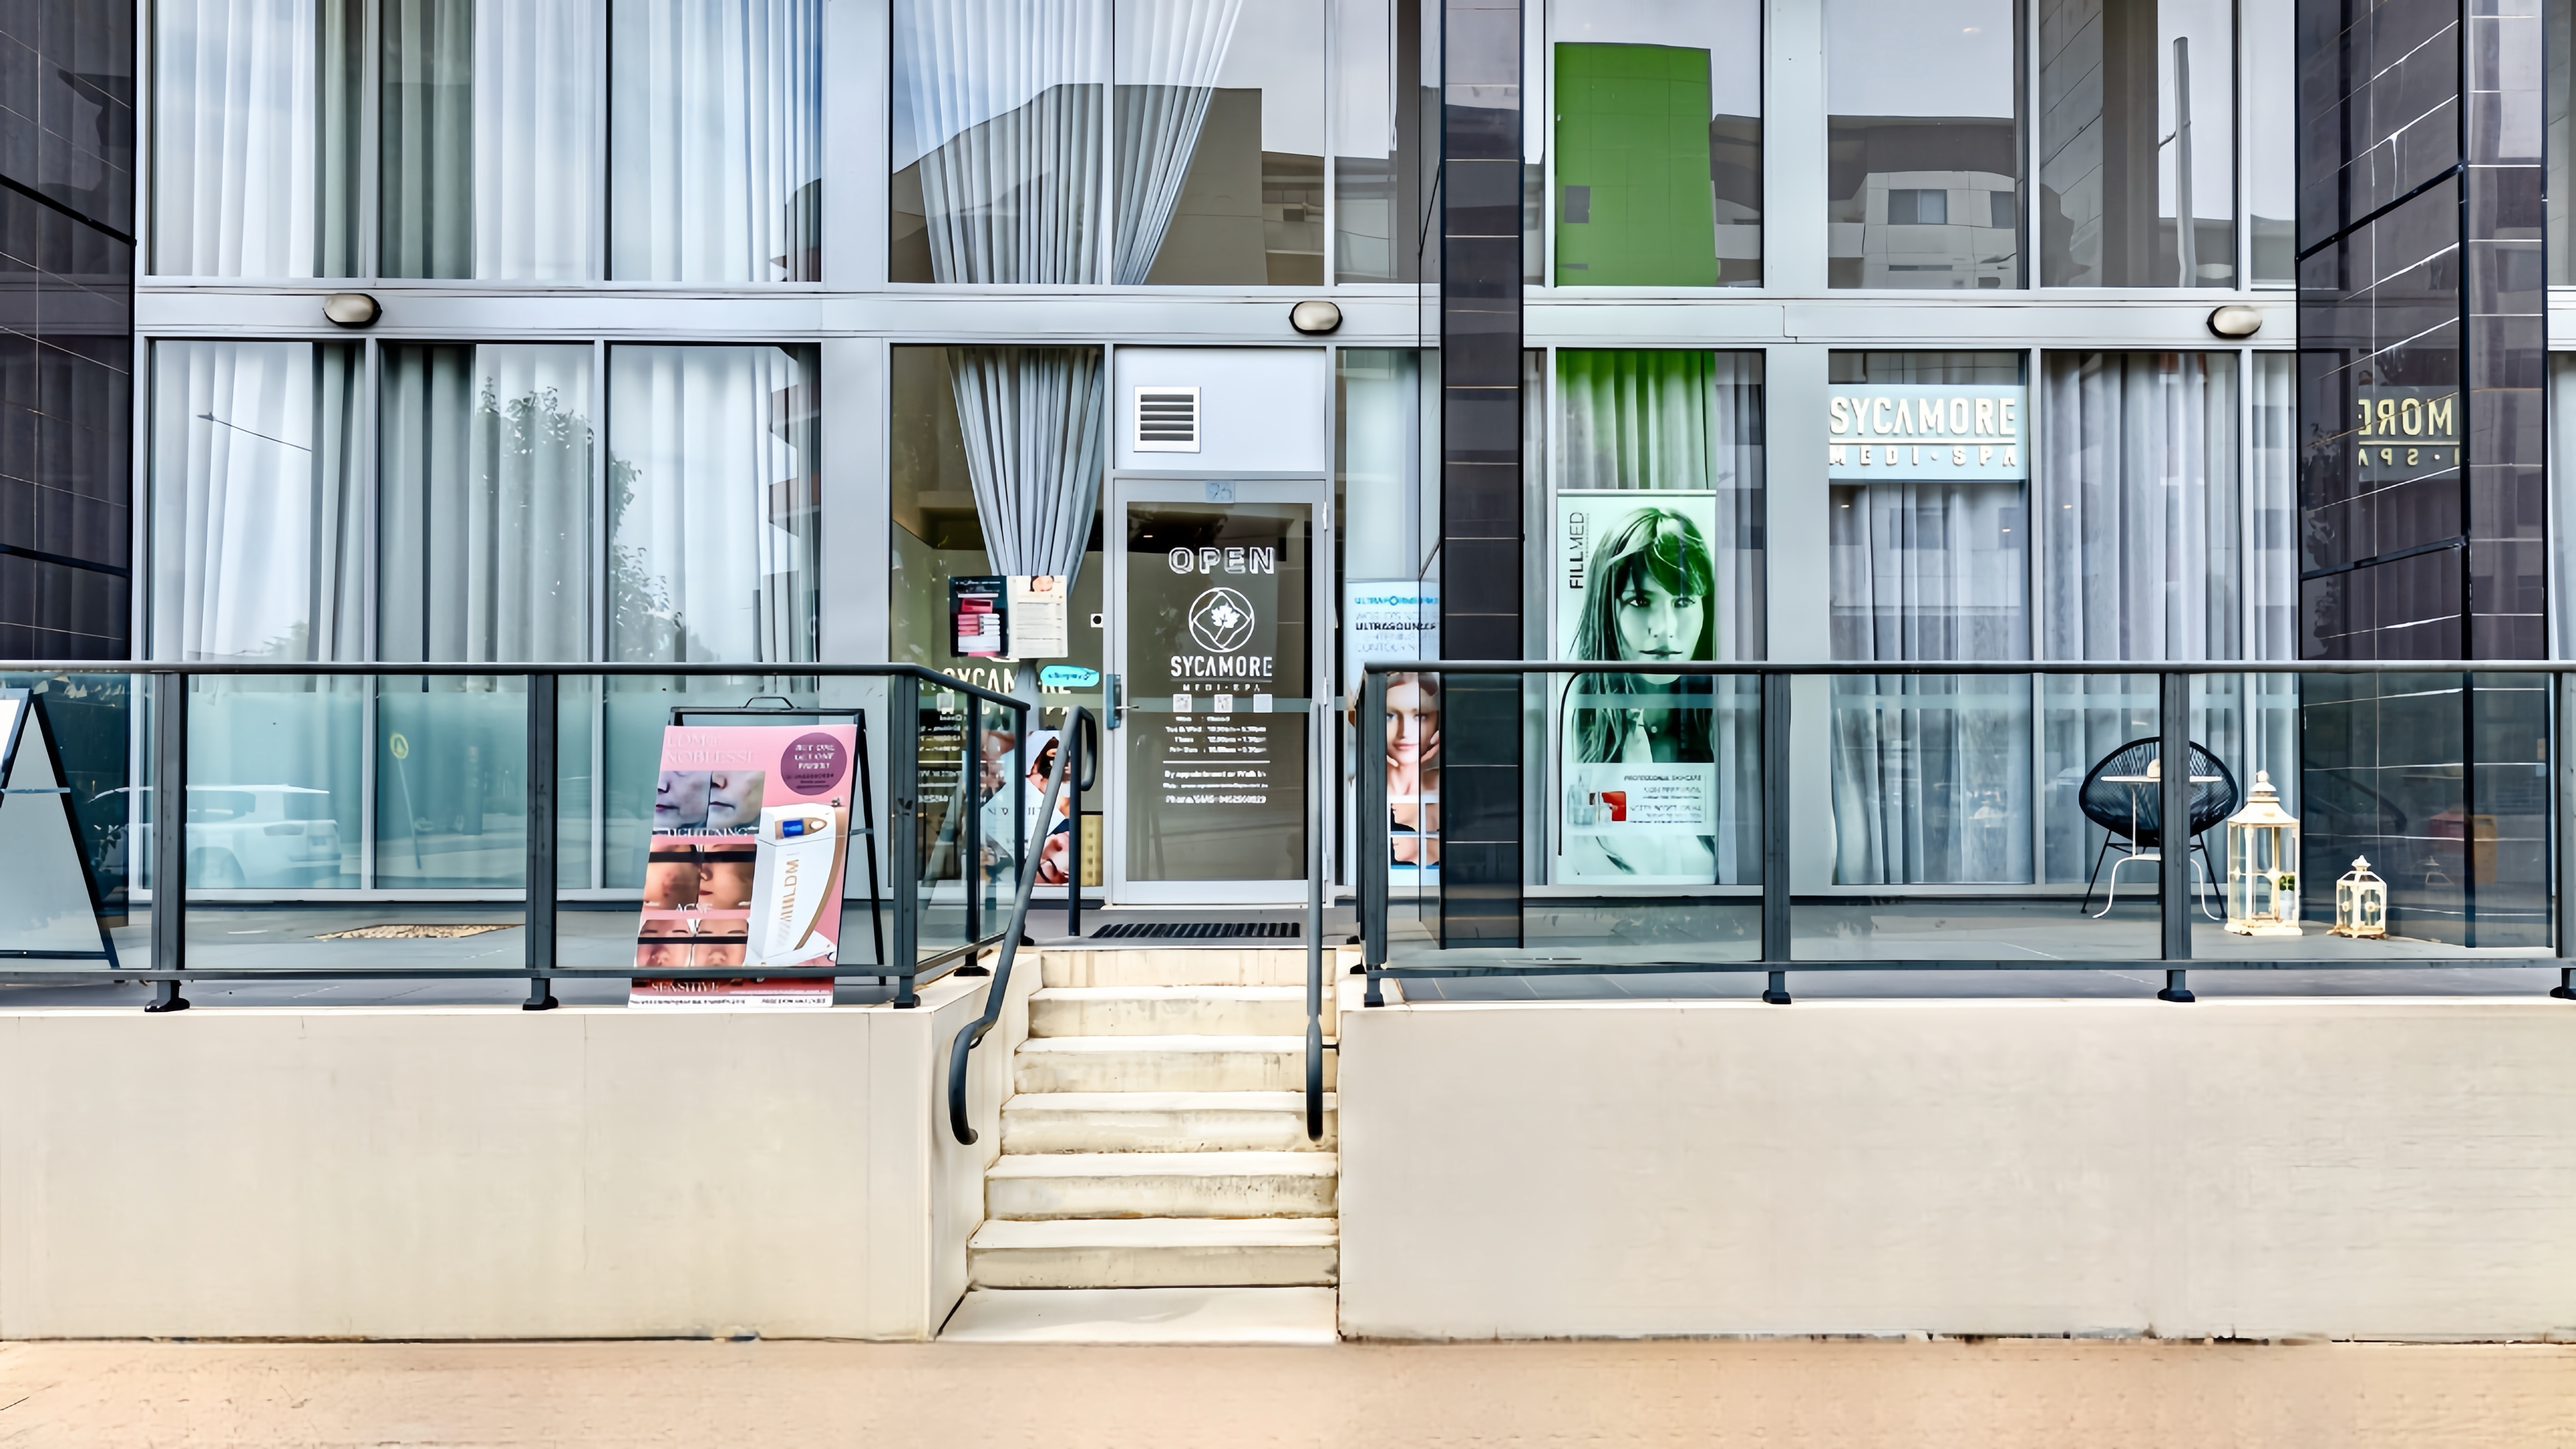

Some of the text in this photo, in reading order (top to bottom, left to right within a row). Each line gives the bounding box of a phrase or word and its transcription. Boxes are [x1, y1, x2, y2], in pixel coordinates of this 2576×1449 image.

[1830, 396, 2016, 435] SYCAMORE
[1168, 546, 1275, 575] OPEN
[1570, 512, 1584, 589] FILLMED
[1171, 656, 1272, 677] SYCAMORE
